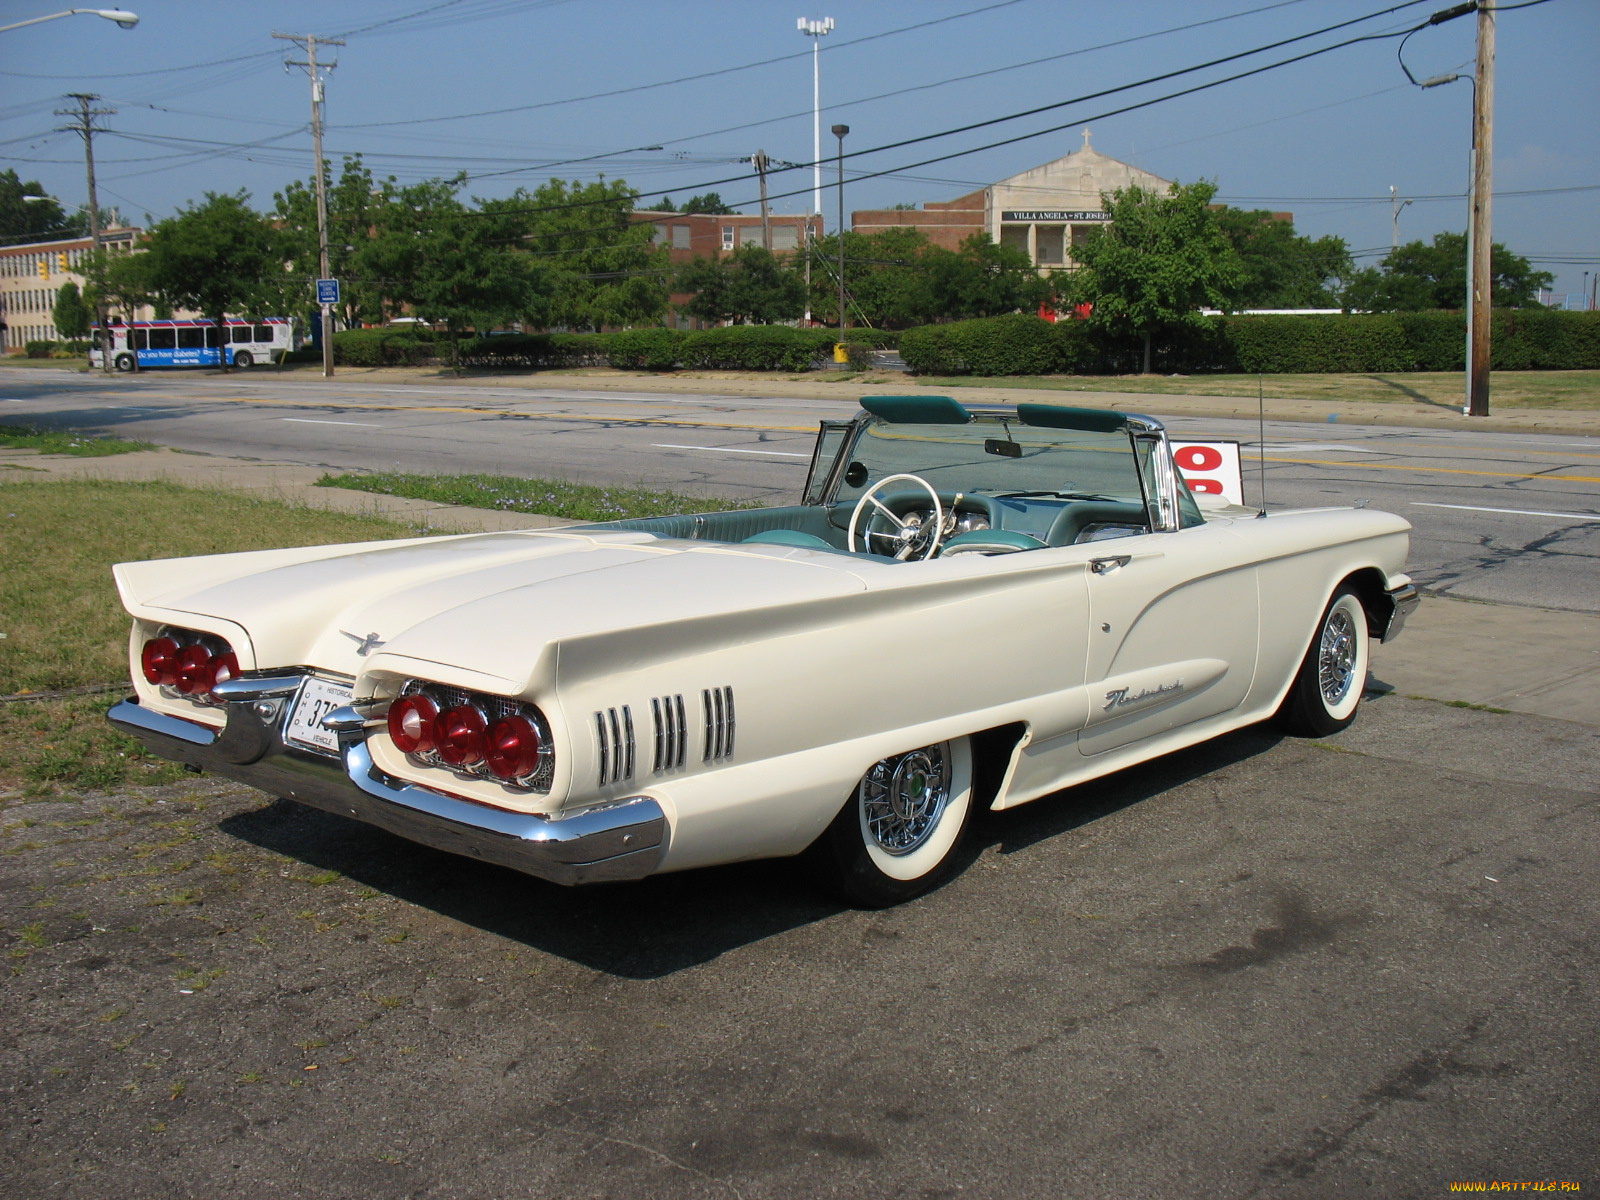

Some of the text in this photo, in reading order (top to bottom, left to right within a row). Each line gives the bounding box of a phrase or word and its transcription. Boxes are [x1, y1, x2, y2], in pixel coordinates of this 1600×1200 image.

[1013, 212, 1036, 220] VILLA
[137, 350, 145, 358] Do
[147, 351, 158, 360] you
[159, 350, 173, 358] have
[173, 349, 201, 358] diabetes?
[327, 686, 353, 699] HISTORICAL
[1102, 679, 1184, 709] Thunderbird
[294, 692, 311, 726] OHIO
[312, 734, 333, 746] VEHICLE
